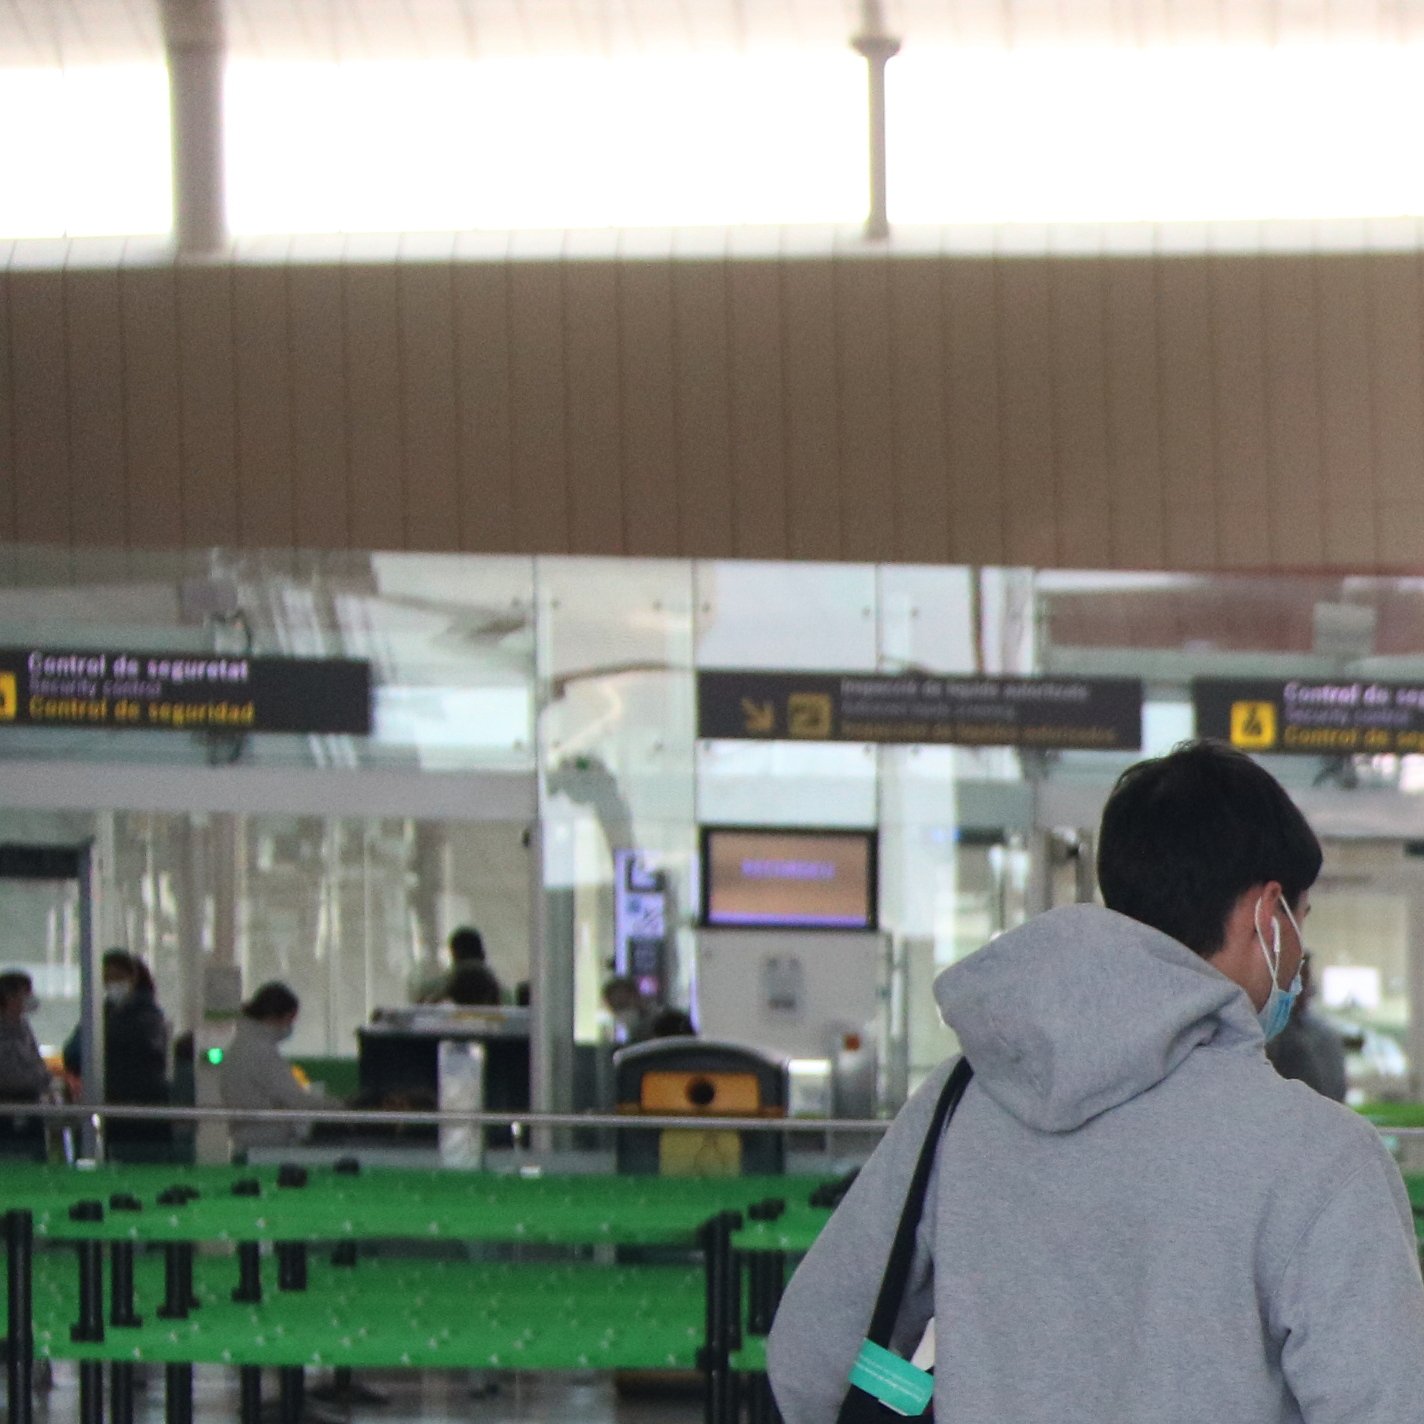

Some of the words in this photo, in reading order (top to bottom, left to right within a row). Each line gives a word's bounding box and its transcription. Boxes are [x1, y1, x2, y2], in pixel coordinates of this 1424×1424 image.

[28, 650, 106, 679] Control
[113, 653, 140, 680] de
[147, 658, 248, 685] seguretat
[1283, 681, 1361, 705] Control
[1363, 684, 1389, 705] de
[29, 694, 107, 721] Control
[113, 697, 140, 722] de
[148, 700, 256, 728] seguridad
[1284, 726, 1358, 749] Control
[1363, 727, 1389, 748] de
